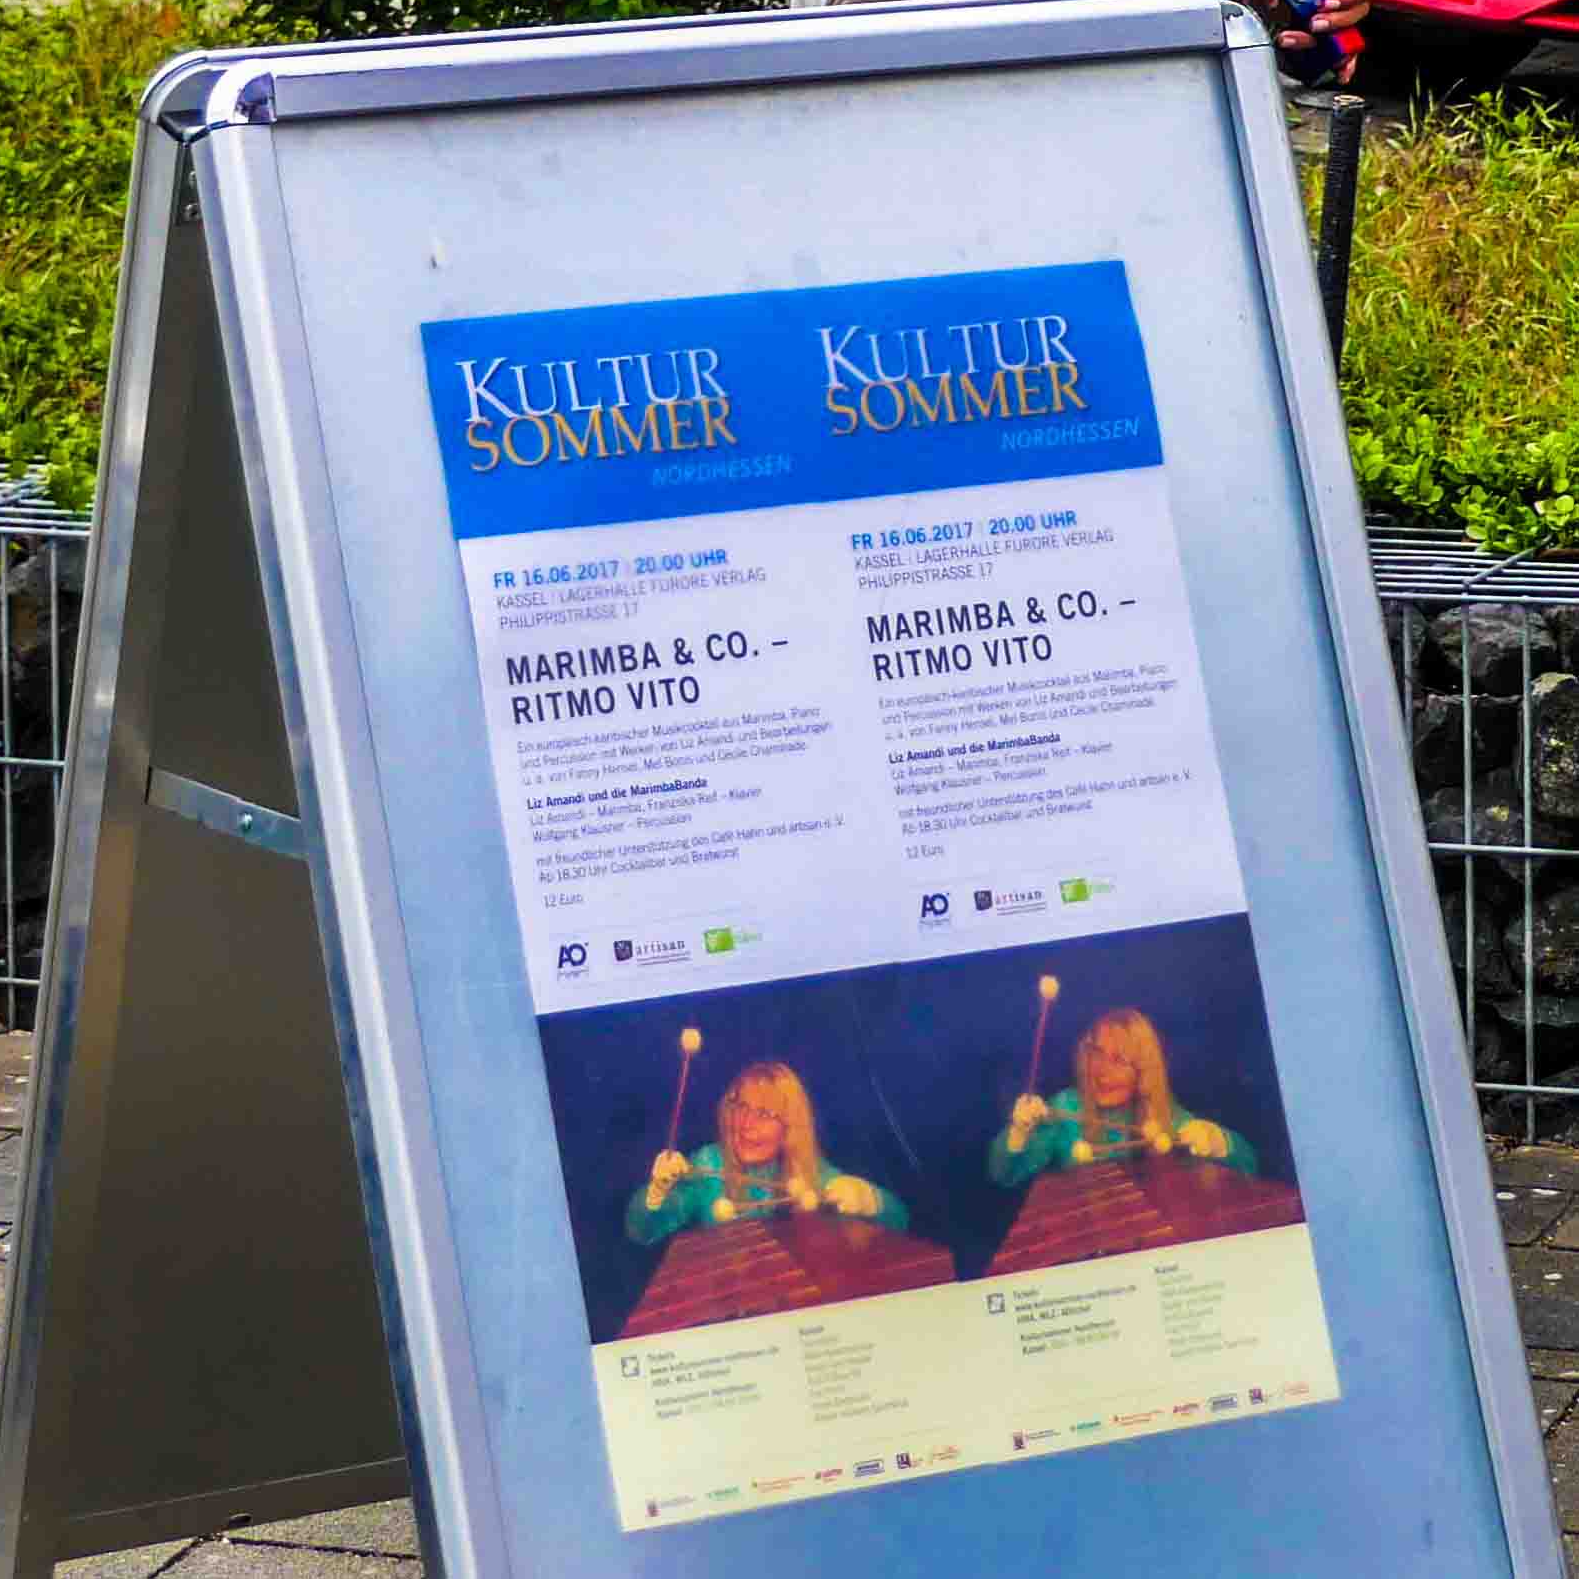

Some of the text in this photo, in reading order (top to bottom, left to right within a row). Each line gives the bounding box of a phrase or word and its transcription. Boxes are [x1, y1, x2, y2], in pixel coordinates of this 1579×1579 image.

[813, 315, 1077, 389] KULTUR
[455, 348, 729, 421] KULTUR
[826, 362, 1089, 436] SOMMER
[466, 396, 739, 473] SOMMER
[1000, 417, 1142, 452] NORDHESSEN
[652, 454, 793, 487] NORDHESSEN
[850, 510, 1078, 551] FR 16.06.2017 20.00 UHR
[853, 529, 1114, 571] KASSEL LAGERHALLE FURORE VERLAG
[491, 547, 729, 590] FR 16.06.2017 20.00 UHR
[495, 591, 549, 611] KASSEL
[559, 580, 646, 604] LAGERHALLE
[713, 567, 767, 586] VERLAG
[857, 562, 994, 591] PHILIPPISTRASSE 17
[498, 601, 640, 632] PHILIPPISTRASSE 17
[865, 600, 1015, 643] MARIMBA
[1024, 596, 1047, 624] &
[1055, 589, 1109, 621] CO.
[504, 640, 661, 686] MARIMBA
[671, 636, 695, 666] &
[704, 629, 760, 662] CO.
[872, 633, 1054, 681] RITMO VITO
[511, 675, 701, 725] RITMO VITO
[888, 732, 1061, 763] Liz Amandi und die MarimbaBanda
[526, 777, 708, 809] Liz Amandi und die MarimbaBanda
[917, 891, 951, 918] AO
[554, 941, 589, 969] AO
[634, 938, 686, 957] artisan
